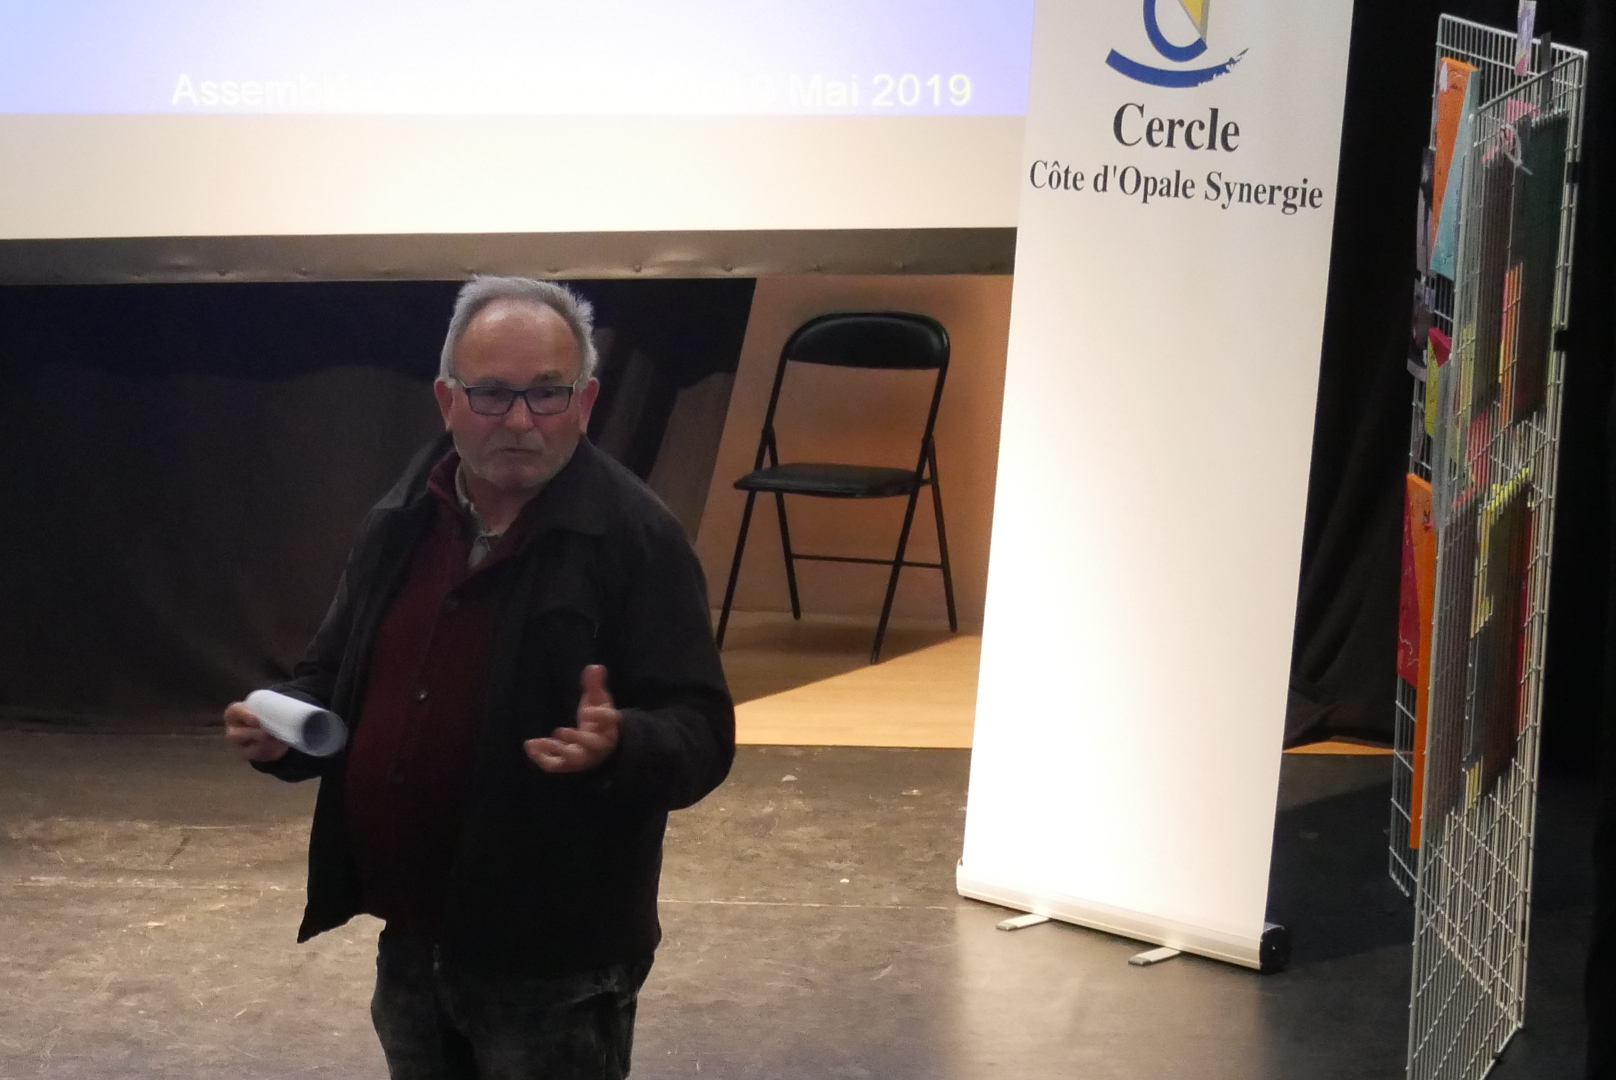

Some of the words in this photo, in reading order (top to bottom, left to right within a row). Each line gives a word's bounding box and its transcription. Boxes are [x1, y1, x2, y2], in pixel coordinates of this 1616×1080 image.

[790, 74, 859, 106] Mai
[871, 73, 973, 106] 2019
[1113, 103, 1240, 152] Cercle
[1030, 160, 1084, 191] Côte
[1093, 165, 1195, 204] d'Opale
[1205, 171, 1323, 215] Synergie
